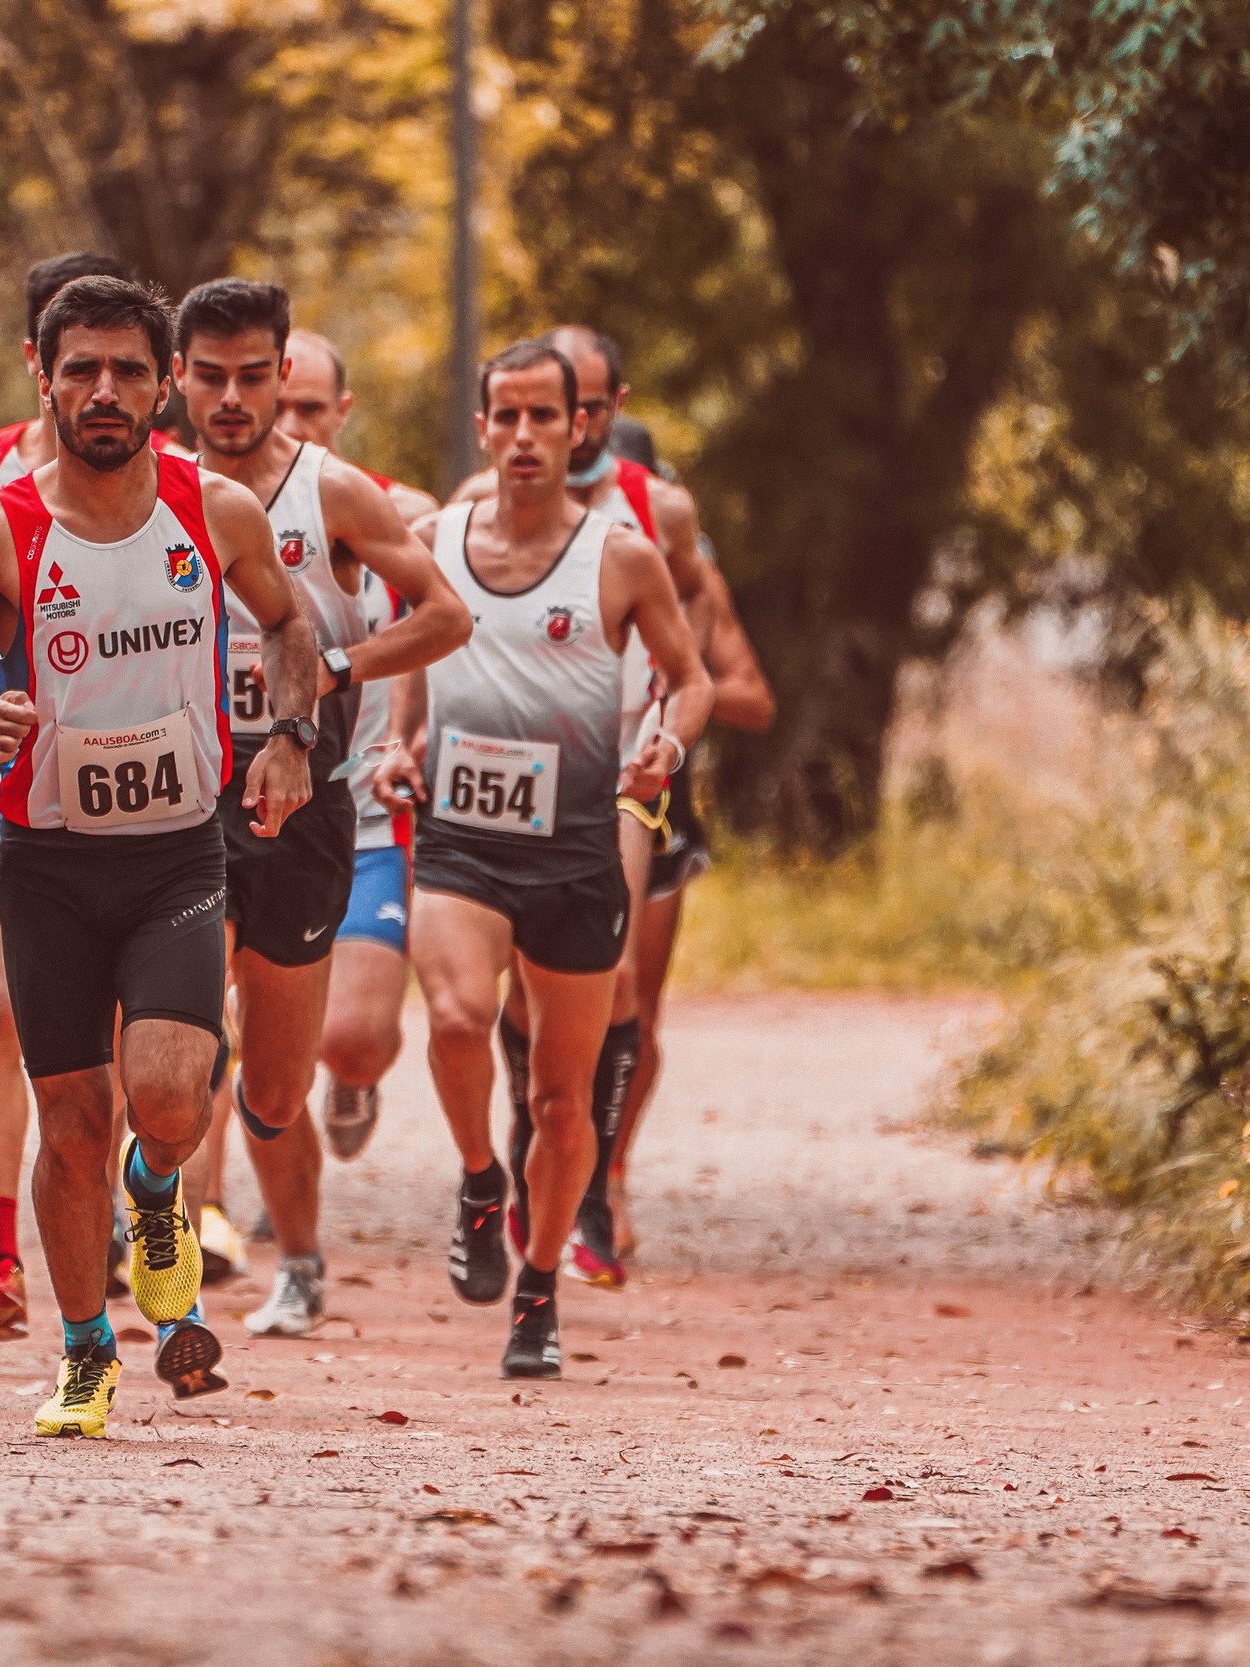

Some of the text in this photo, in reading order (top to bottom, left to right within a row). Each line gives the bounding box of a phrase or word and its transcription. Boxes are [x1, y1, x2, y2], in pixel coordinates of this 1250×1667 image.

[40, 599, 81, 613] MITSUBISHI
[46, 609, 76, 620] MOTORS
[98, 617, 205, 659] UNIVEX
[83, 728, 160, 746] AALISBOA.com
[77, 751, 184, 818] 684
[451, 765, 536, 823] 654
